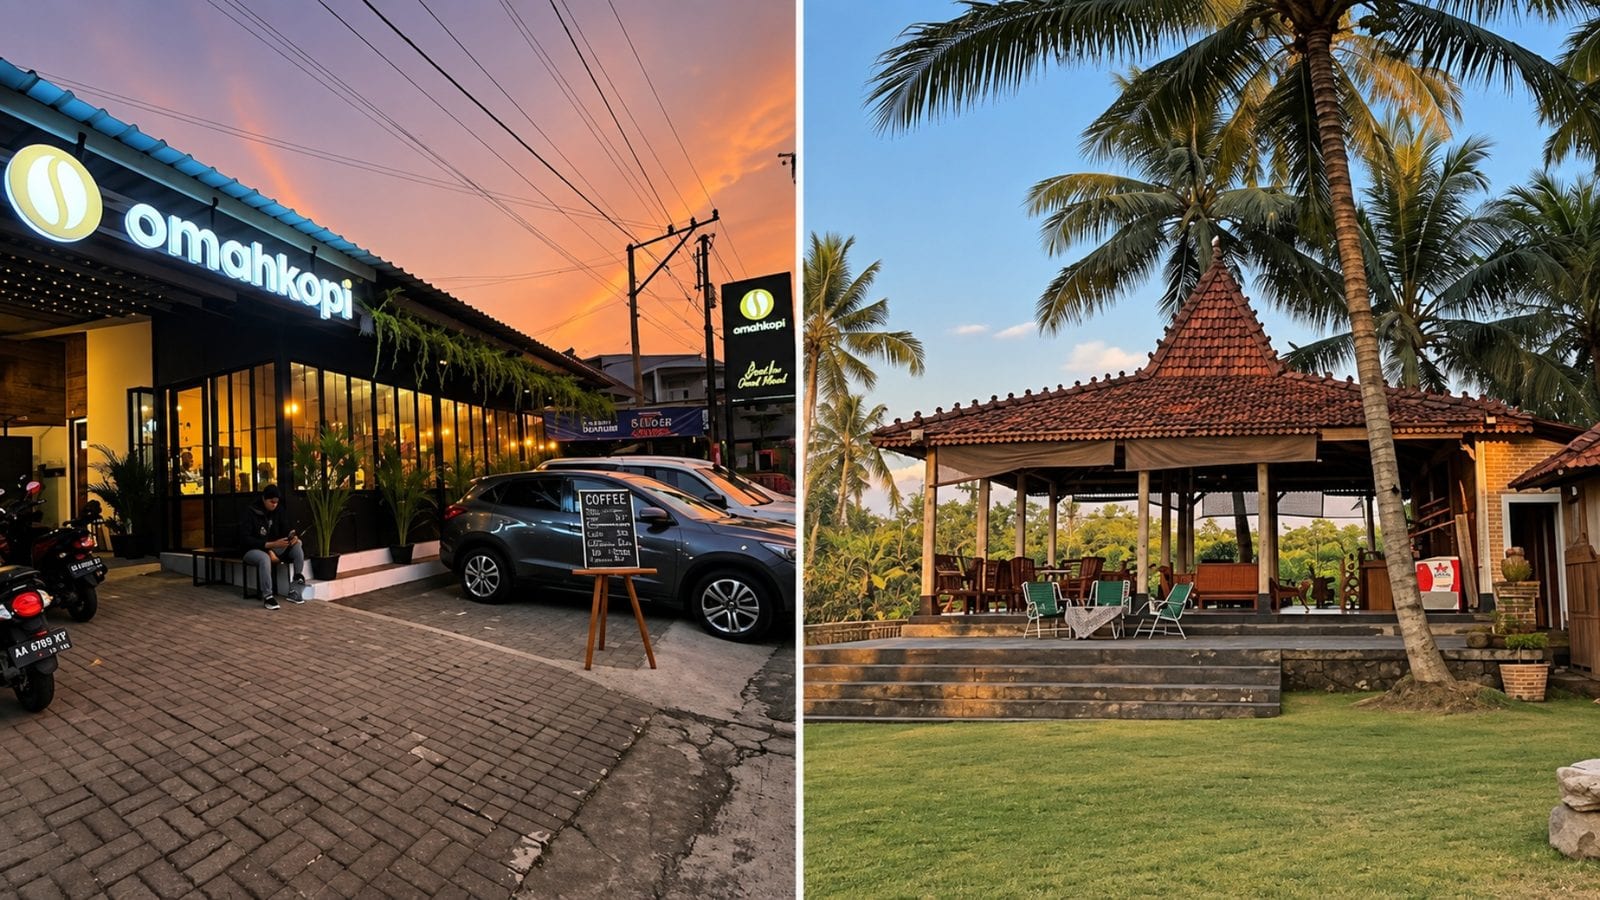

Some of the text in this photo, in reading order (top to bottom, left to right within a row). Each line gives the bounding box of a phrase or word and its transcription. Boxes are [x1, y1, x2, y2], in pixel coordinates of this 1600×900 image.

[124, 203, 353, 320] omahkopi
[733, 318, 786, 335] omahkopi
[585, 493, 627, 505] COFFEE
[15, 646, 29, 658] AA
[30, 637, 53, 651] 6789
